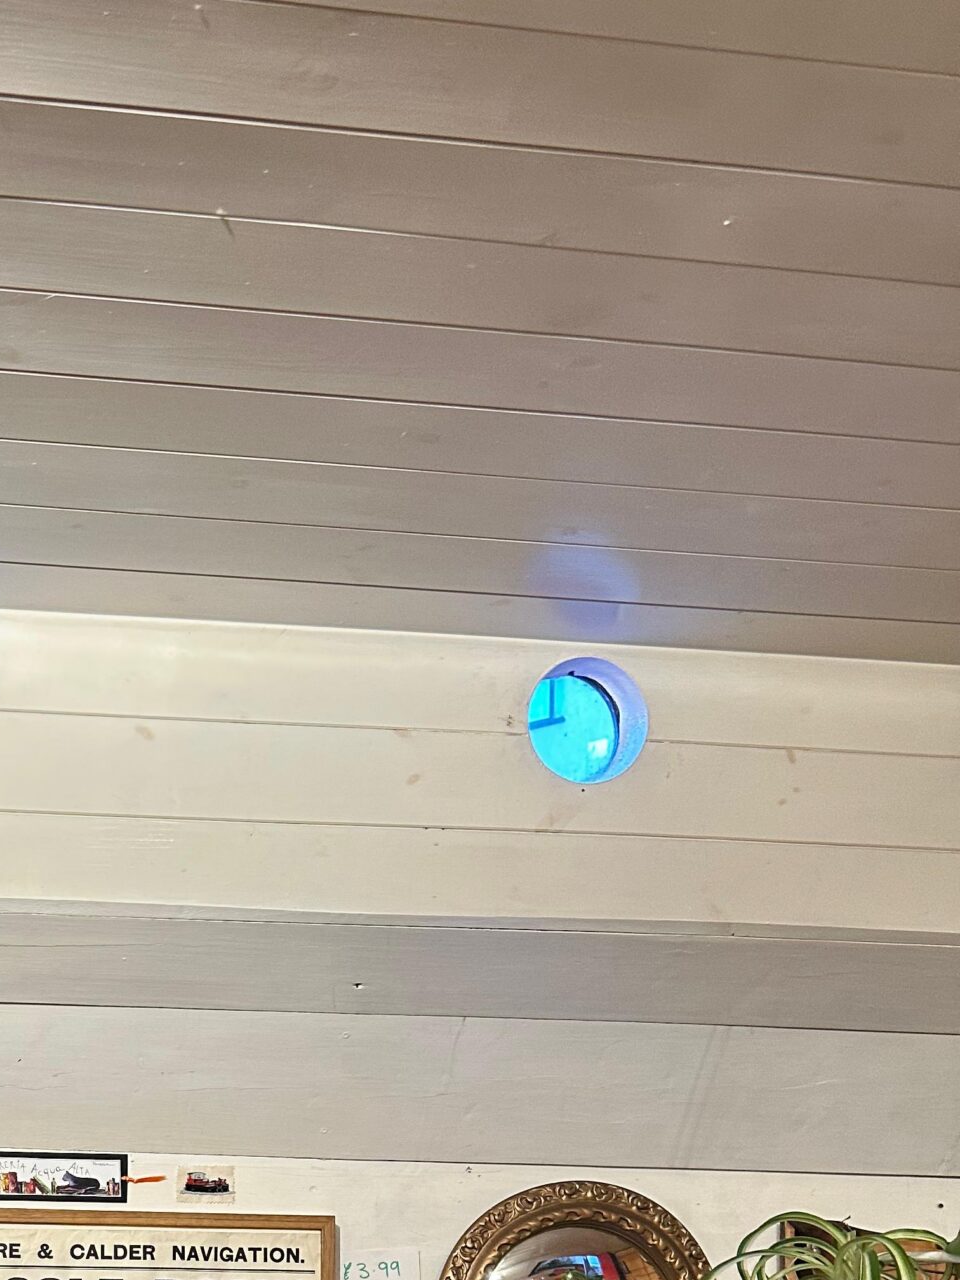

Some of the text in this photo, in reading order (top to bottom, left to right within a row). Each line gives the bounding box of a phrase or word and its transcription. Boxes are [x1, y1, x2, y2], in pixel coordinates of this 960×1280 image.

[37, 1243, 54, 1259] &
[69, 1244, 156, 1261] CALDER
[172, 1246, 305, 1264] NAVIGATION.
